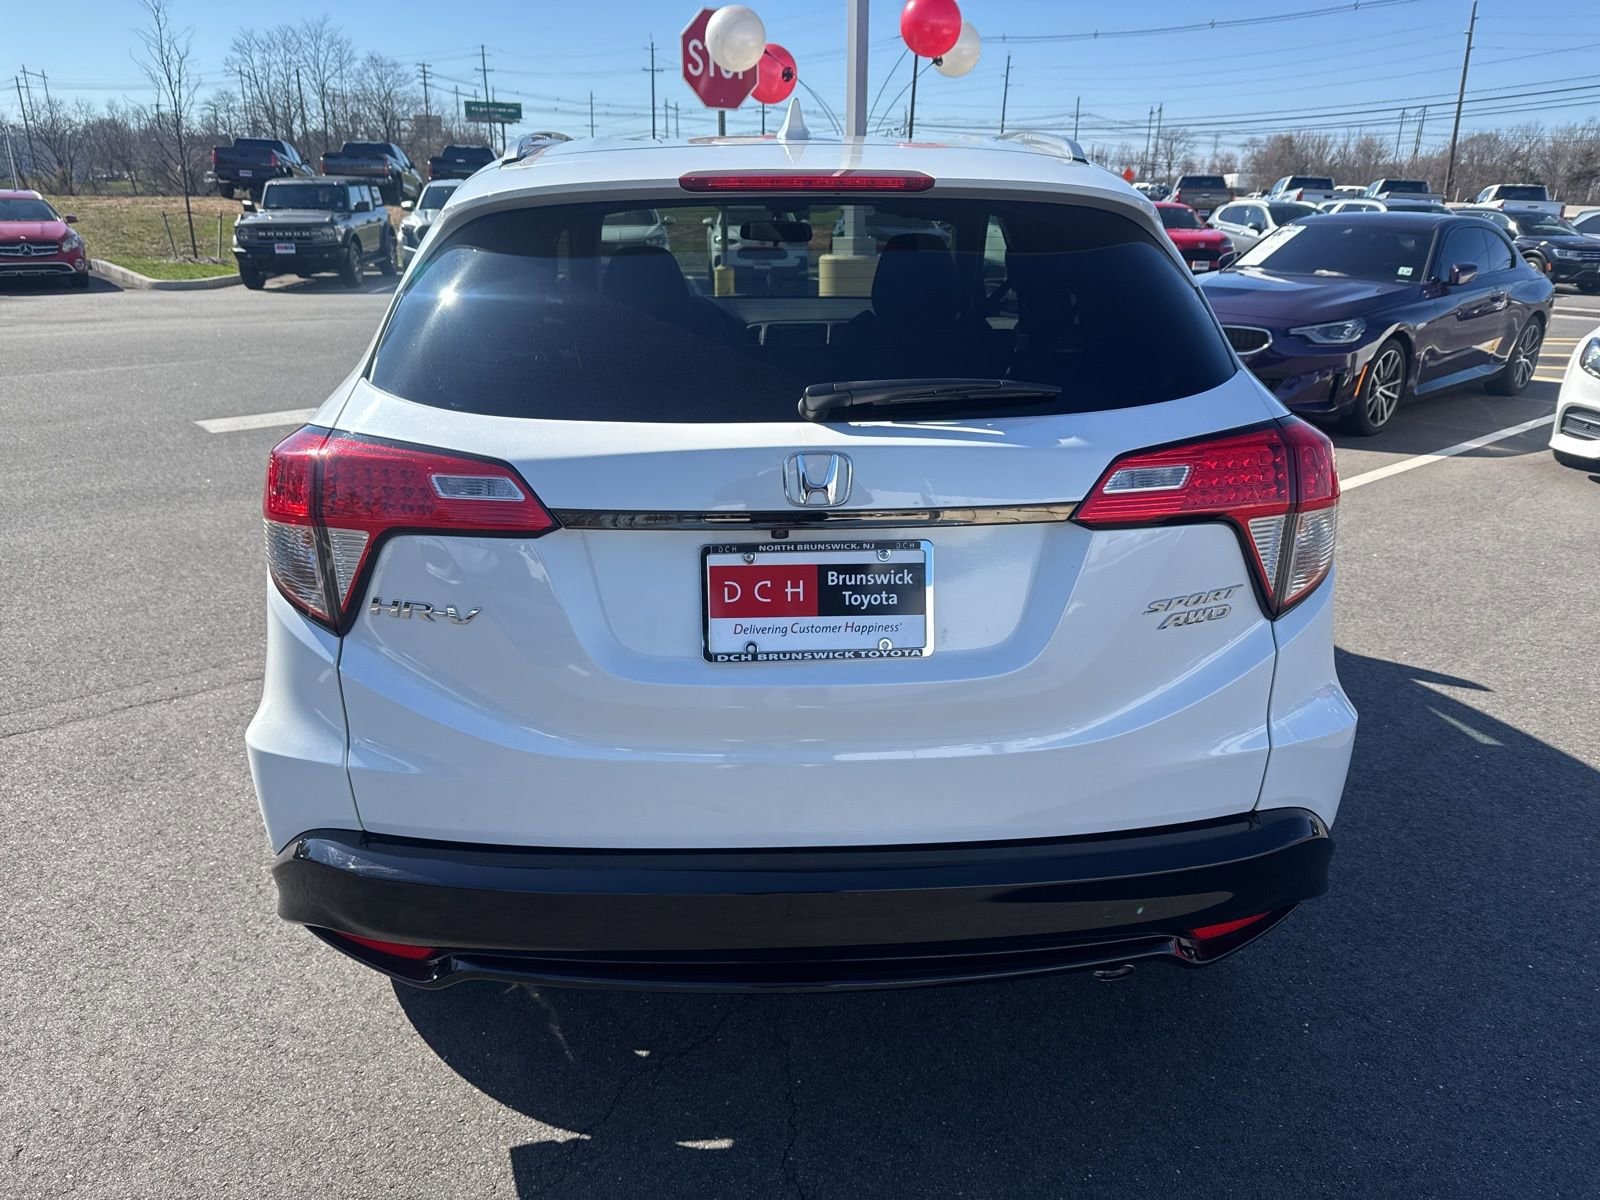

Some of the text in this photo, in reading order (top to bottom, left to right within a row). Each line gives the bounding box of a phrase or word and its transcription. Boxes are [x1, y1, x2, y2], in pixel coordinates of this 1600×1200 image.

[688, 38, 743, 79] ST
[758, 544, 795, 552] NORTH
[863, 542, 875, 550] NJ
[828, 570, 913, 586] Brunswick
[842, 590, 898, 610] Toyota
[1142, 583, 1244, 615] SPORT
[370, 597, 482, 625] HR-V
[1157, 604, 1232, 630] AWD
[733, 623, 788, 636] Delivering
[790, 622, 842, 634] Customer
[717, 649, 922, 662] DCH BRUNSWICK TOYOTA
